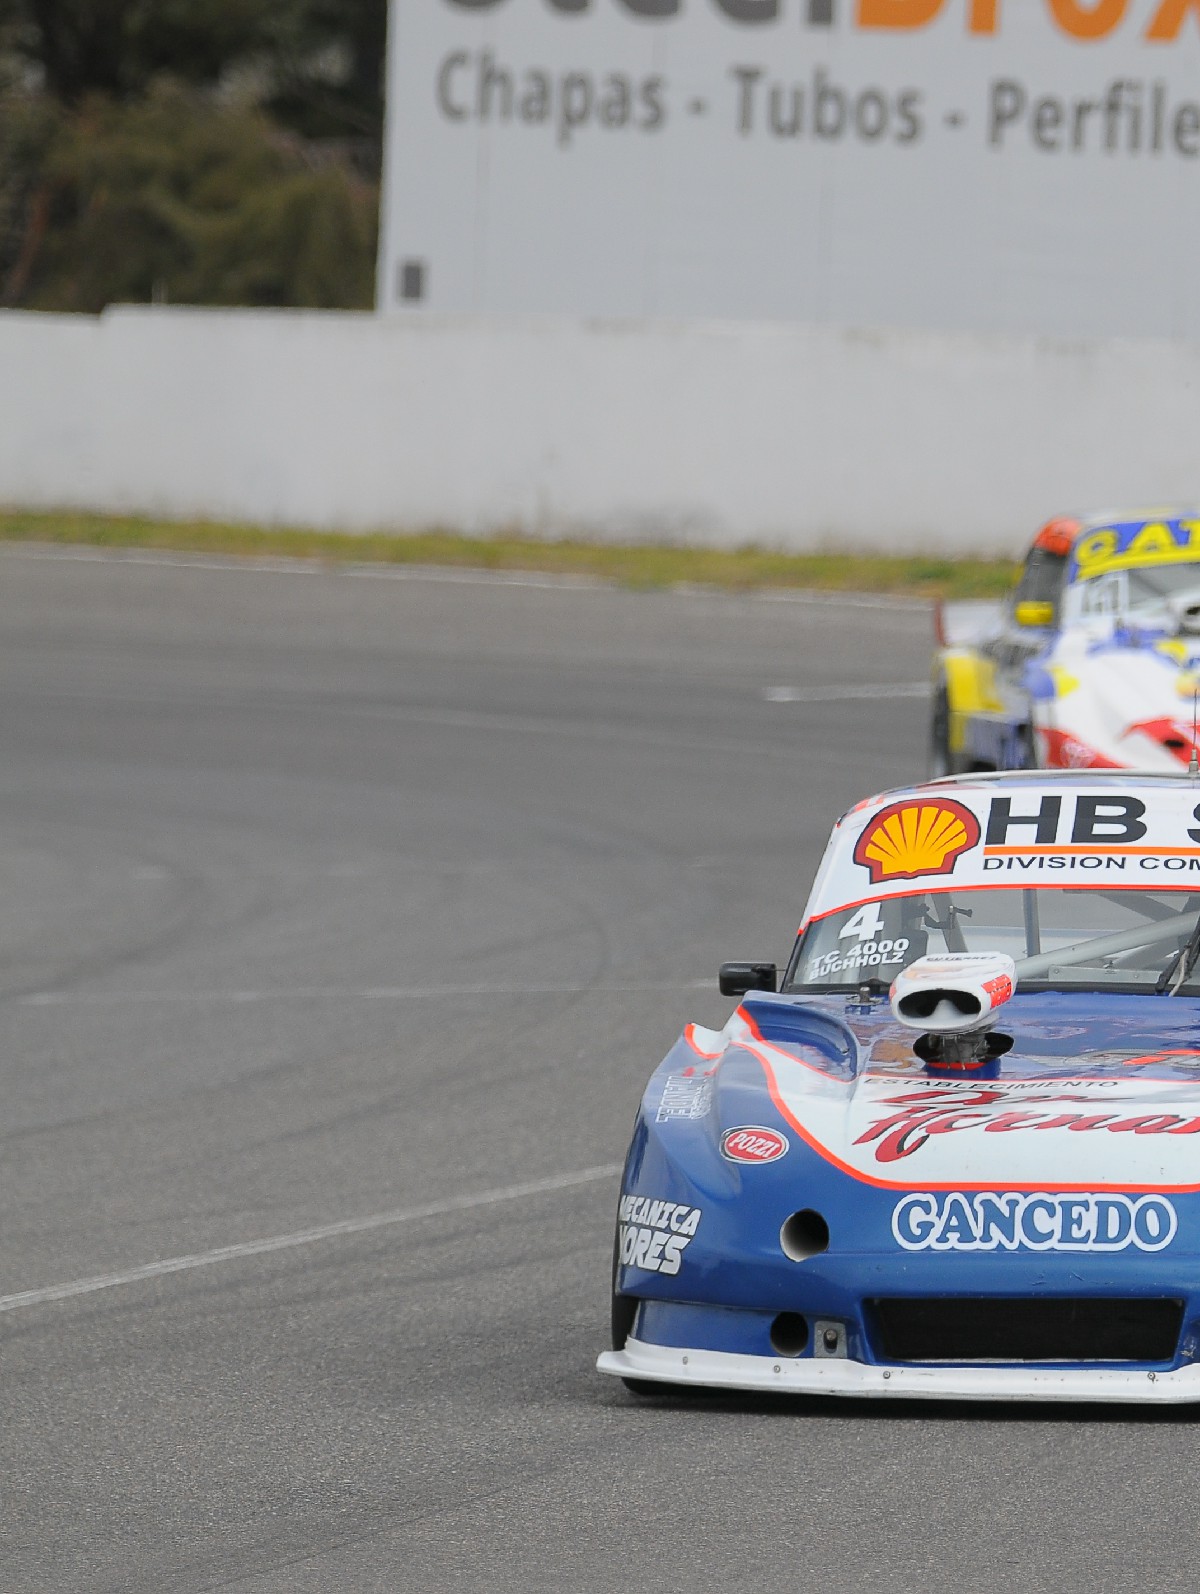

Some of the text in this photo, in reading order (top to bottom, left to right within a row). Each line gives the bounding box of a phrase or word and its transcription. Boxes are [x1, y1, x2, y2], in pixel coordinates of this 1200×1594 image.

[436, 48, 667, 150] Chapas
[728, 62, 924, 145] Tubos
[985, 796, 1147, 845] HB
[983, 855, 1126, 871] DIVISION
[838, 902, 884, 942] 4
[808, 950, 905, 981] BUCHHOLZ
[811, 938, 910, 970] TC 4000
[863, 1077, 1119, 1090] ESTABLECIMIENTO
[728, 1132, 782, 1158] POZZI
[890, 1191, 1179, 1252] GANCEDO
